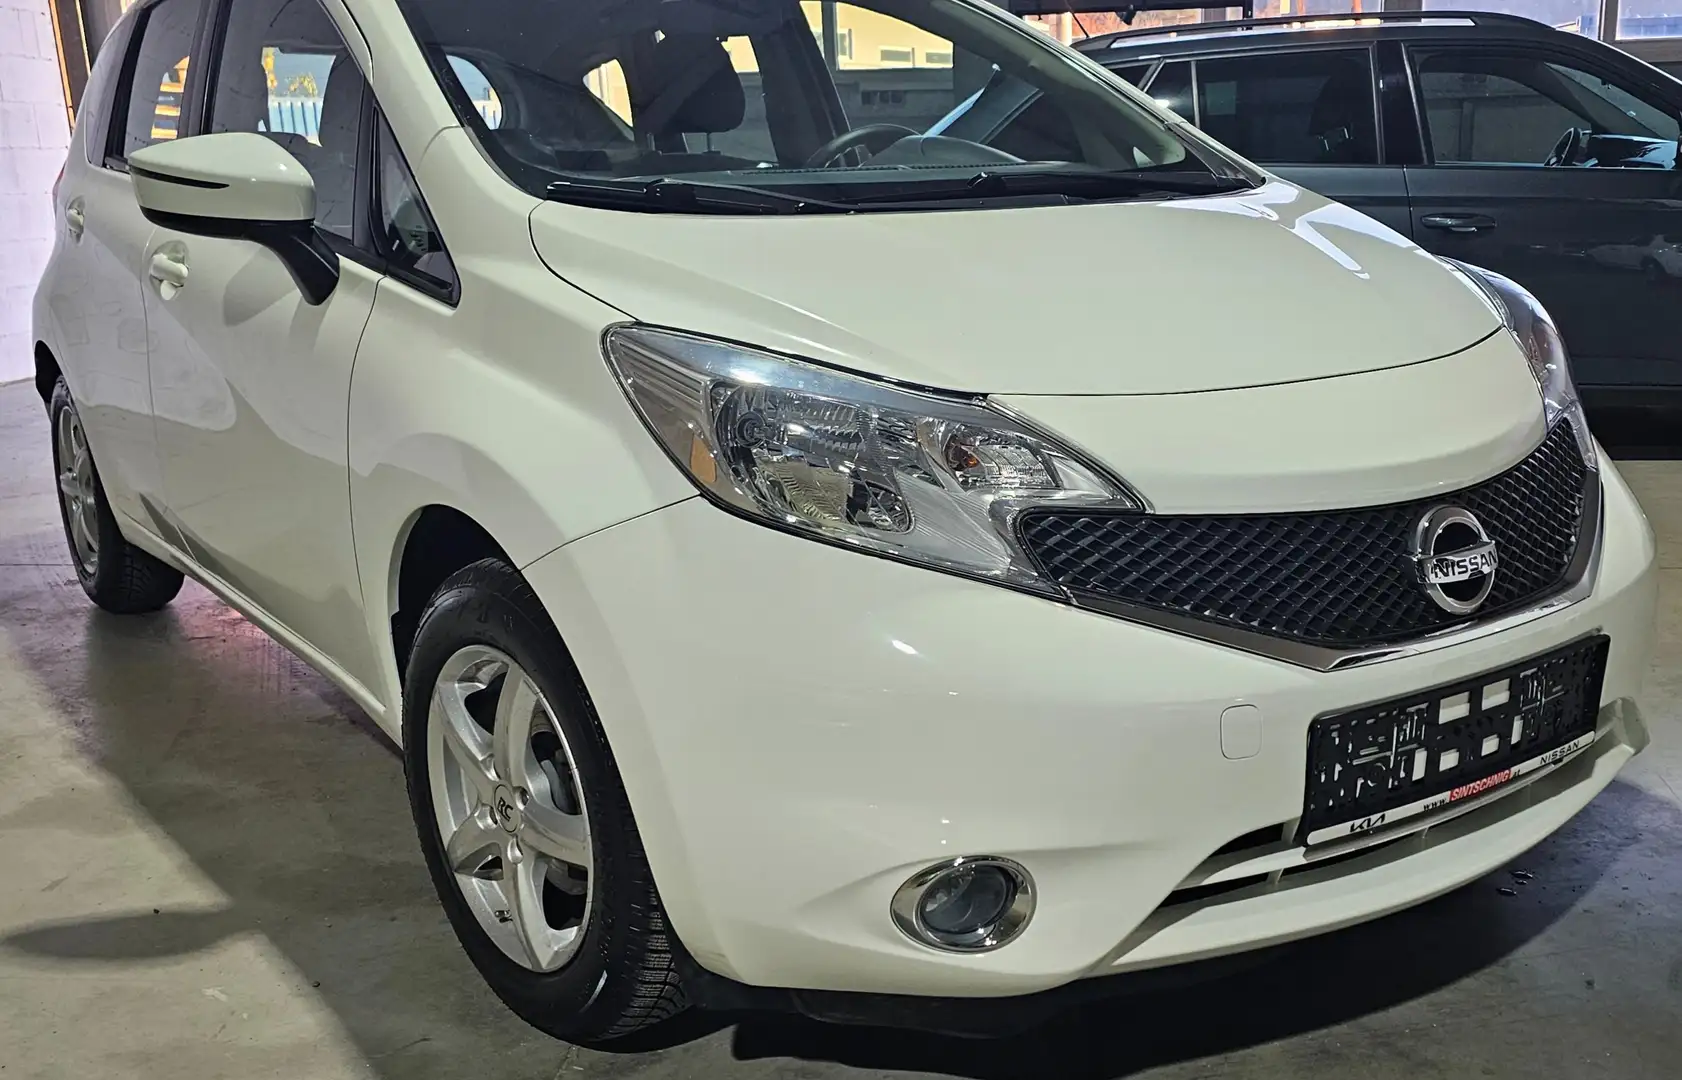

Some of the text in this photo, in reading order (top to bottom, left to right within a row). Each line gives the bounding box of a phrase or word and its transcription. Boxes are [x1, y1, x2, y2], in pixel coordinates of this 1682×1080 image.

[1431, 550, 1498, 578] NISSAN
[1540, 740, 1580, 765] NISSAN
[497, 796, 513, 821] RC
